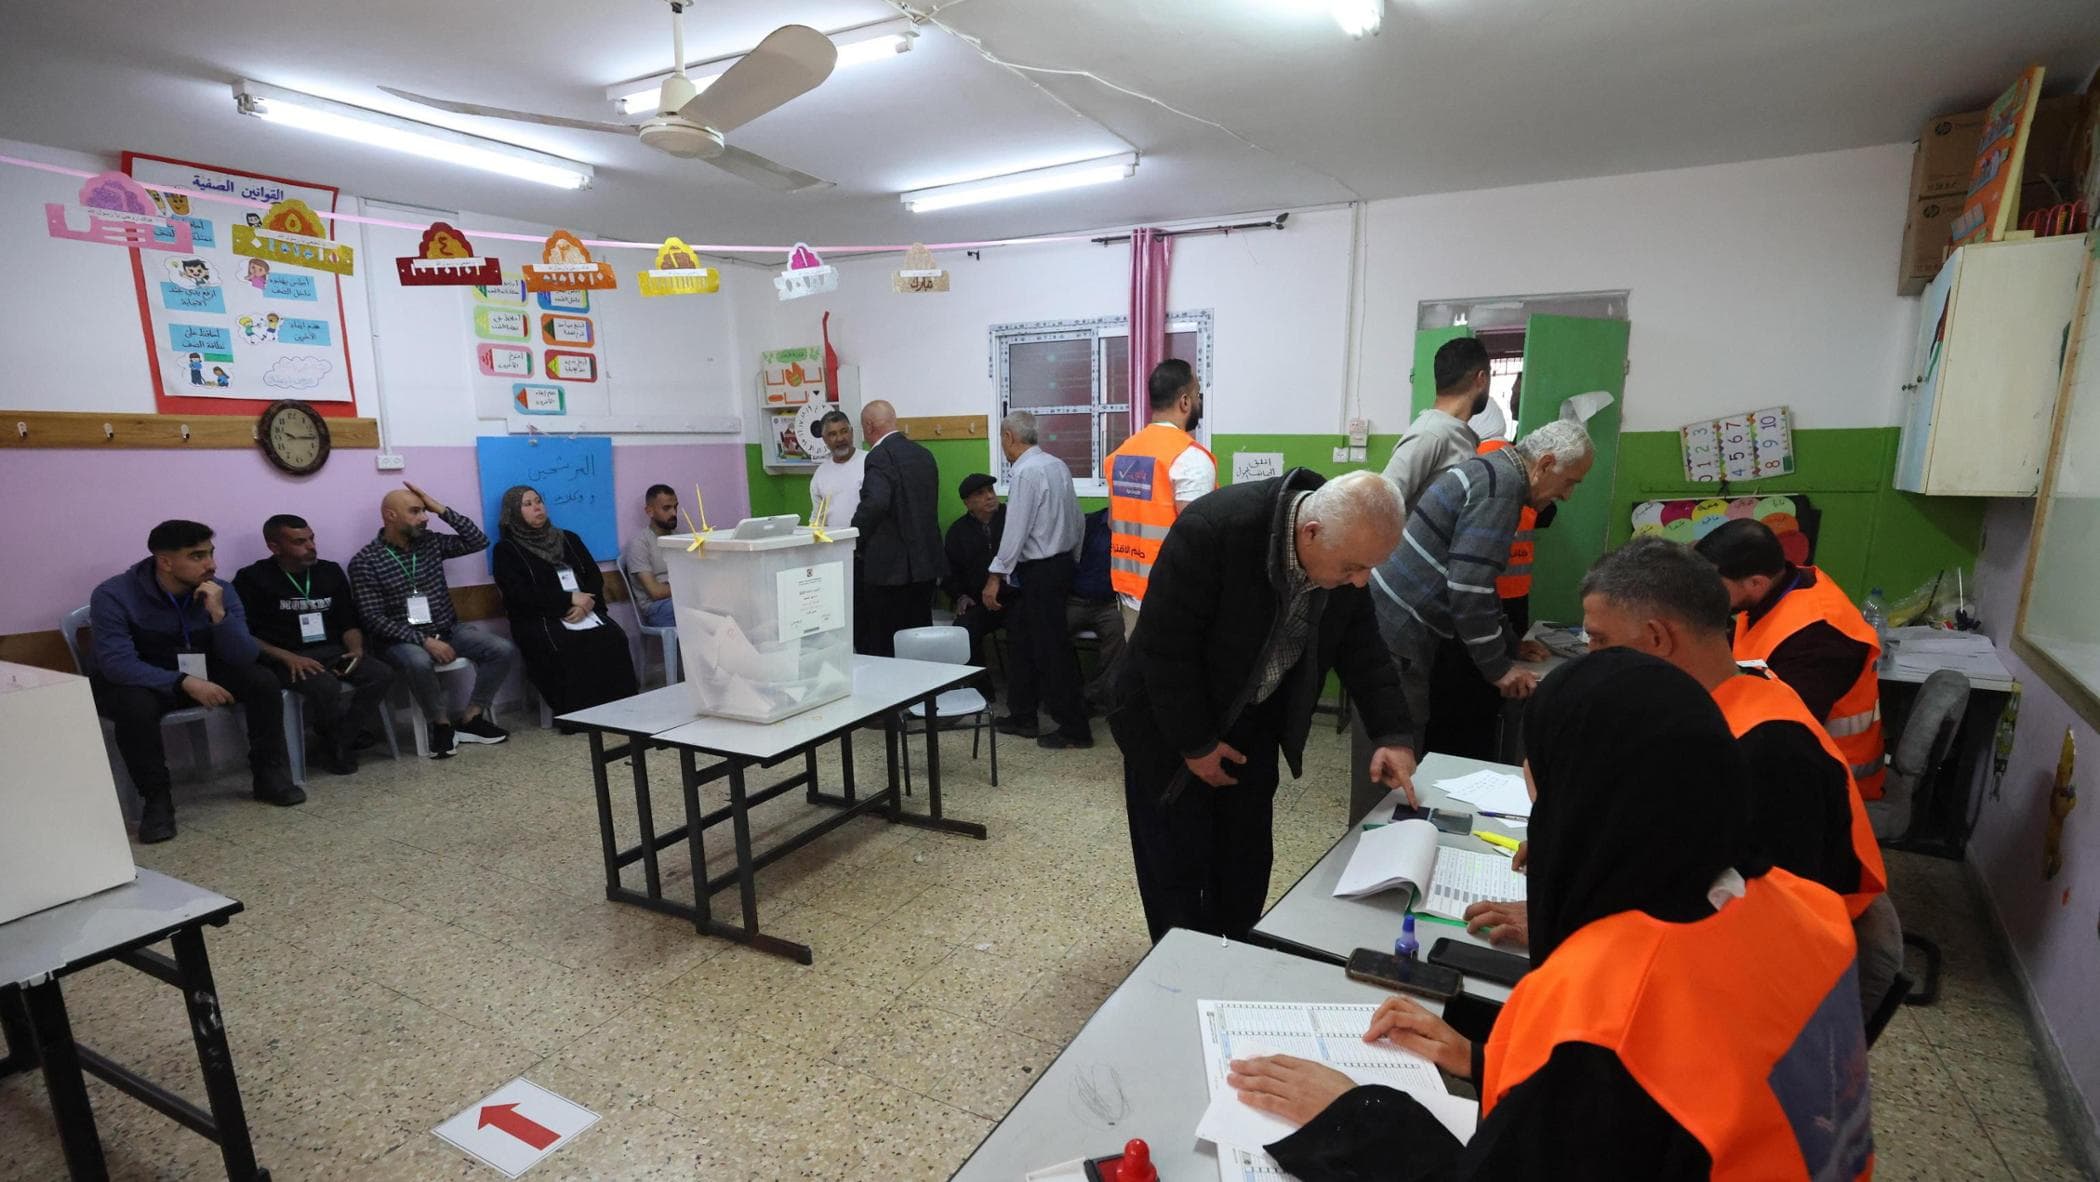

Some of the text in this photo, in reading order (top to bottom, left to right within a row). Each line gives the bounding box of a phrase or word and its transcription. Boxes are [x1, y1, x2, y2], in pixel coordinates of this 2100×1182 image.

[192, 175, 284, 203] القوانين الصفية
[1693, 427, 1708, 436] 3
[1760, 415, 1780, 469] 8 9 10
[1695, 446, 1709, 454] 2
[1726, 422, 1745, 476] 4 5 6 7
